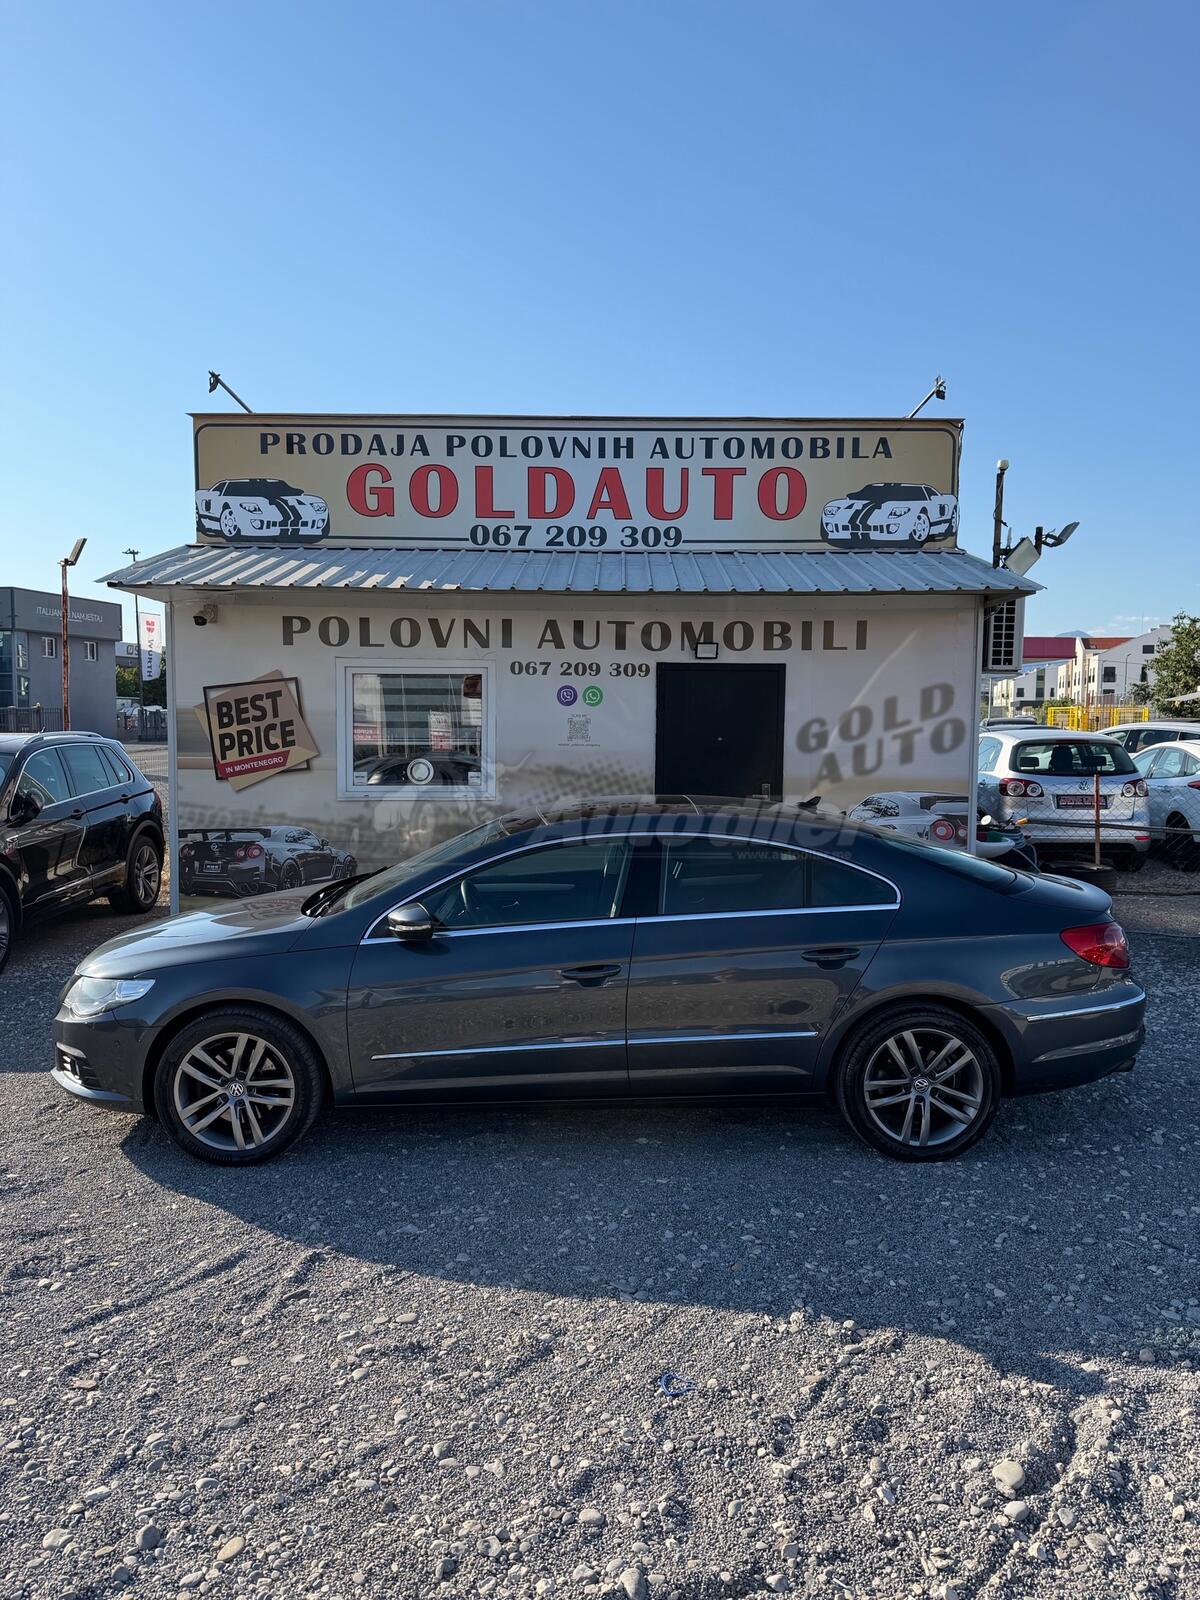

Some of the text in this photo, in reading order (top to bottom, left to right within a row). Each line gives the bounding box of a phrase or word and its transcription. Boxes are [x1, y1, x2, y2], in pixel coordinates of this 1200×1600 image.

[260, 432, 893, 459] PRODAJA POLOVNIH AUTOMOBILA
[346, 462, 808, 520] GOLDAUTO
[469, 524, 683, 548] 067 209 309
[282, 615, 868, 652] POLOVNI AUTOMOBILI
[509, 660, 651, 678] 067 209 309
[216, 689, 283, 730] BEST
[796, 682, 956, 754] GOLD
[218, 719, 296, 761] PRICE
[810, 717, 966, 790] AUTO
[225, 756, 284, 774] IN MONTENEGRO
